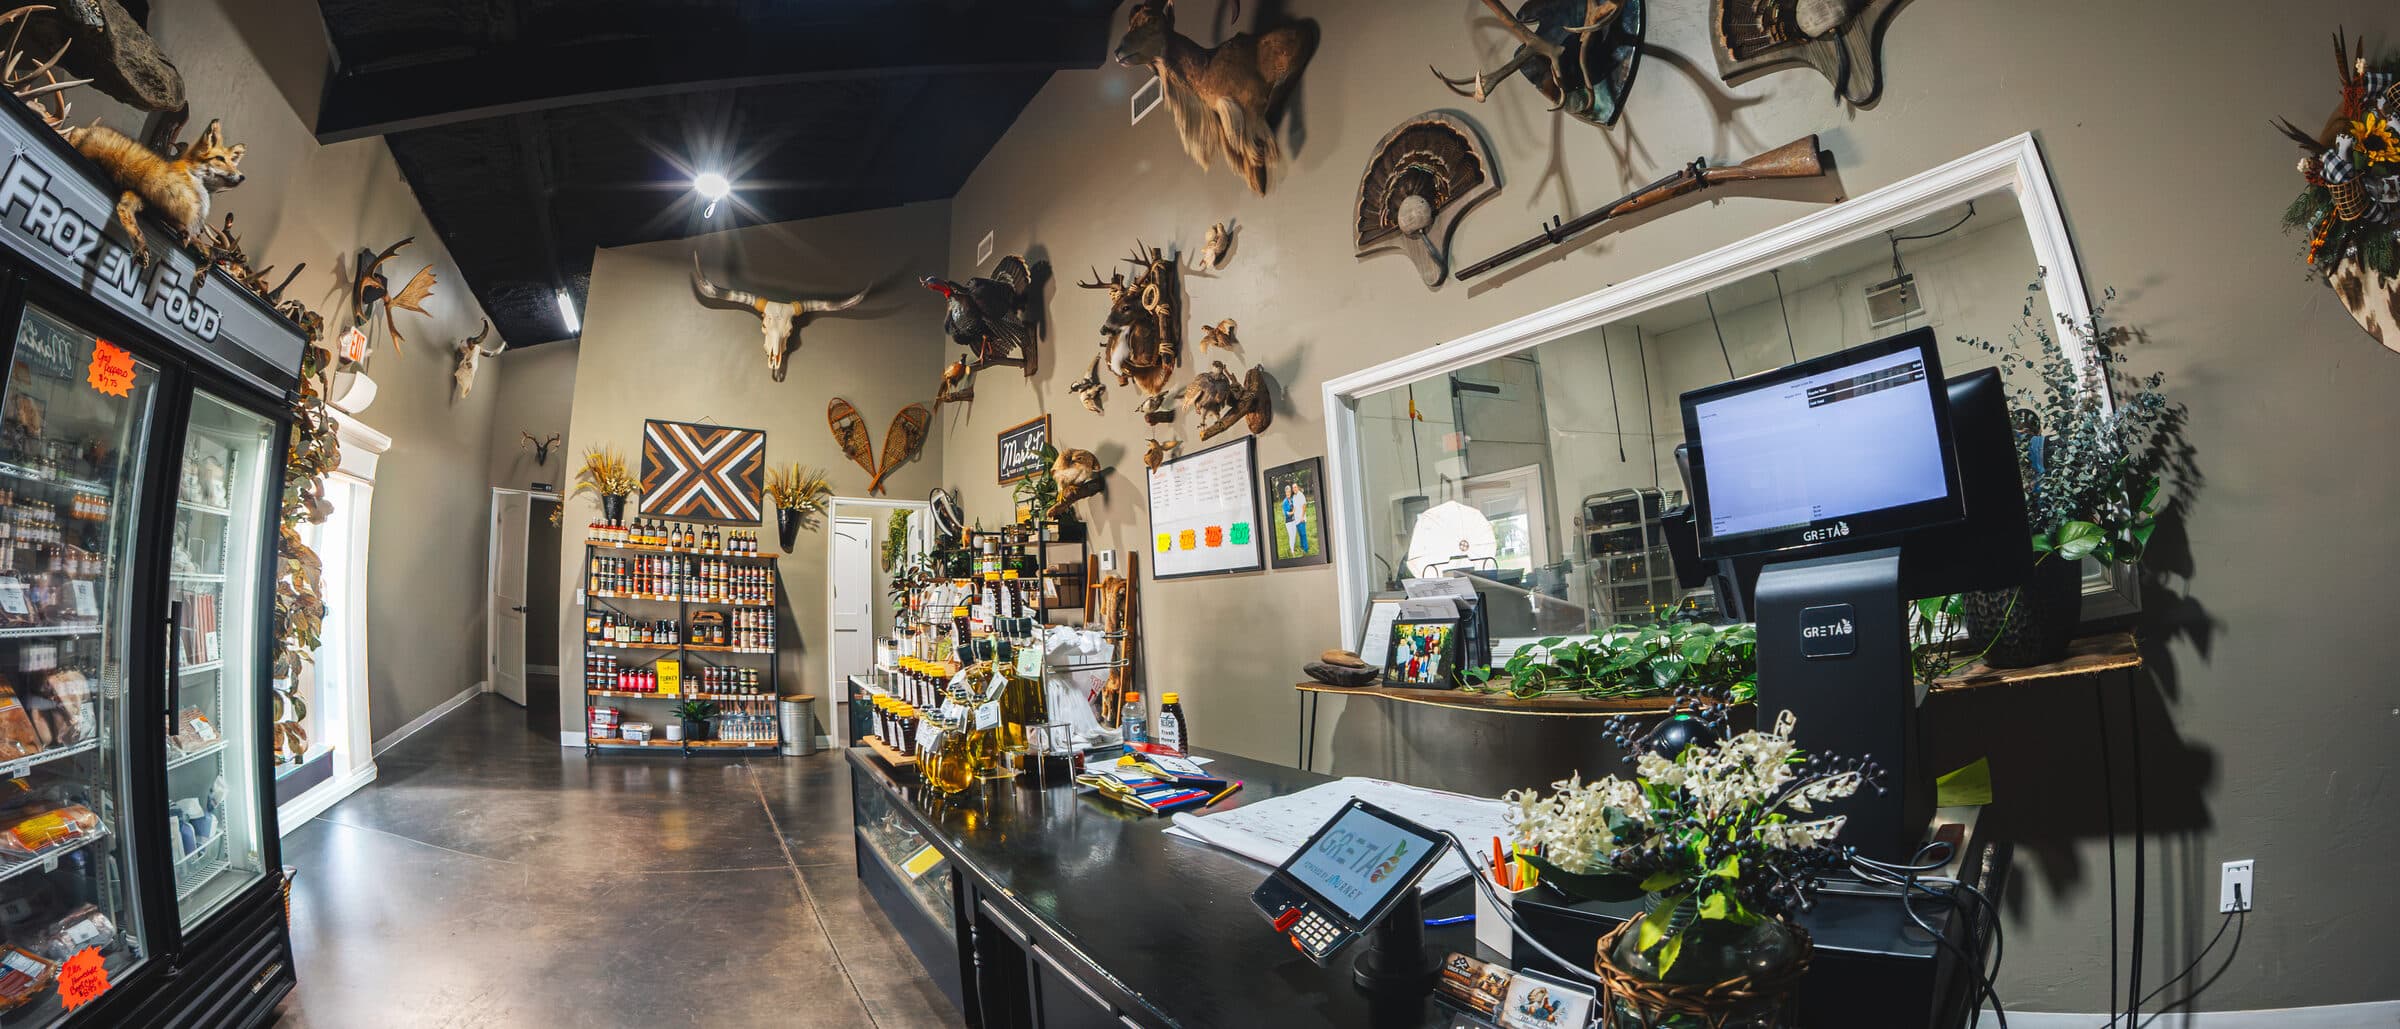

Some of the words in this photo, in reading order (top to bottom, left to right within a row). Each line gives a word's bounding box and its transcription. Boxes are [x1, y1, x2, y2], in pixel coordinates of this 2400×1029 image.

[143, 258, 221, 343] FOOD
[349, 329, 366, 362] EXIT
[1803, 523, 1841, 542] GRETA
[1803, 621, 1844, 638] GRETA
[1318, 828, 1393, 878] GRETA
